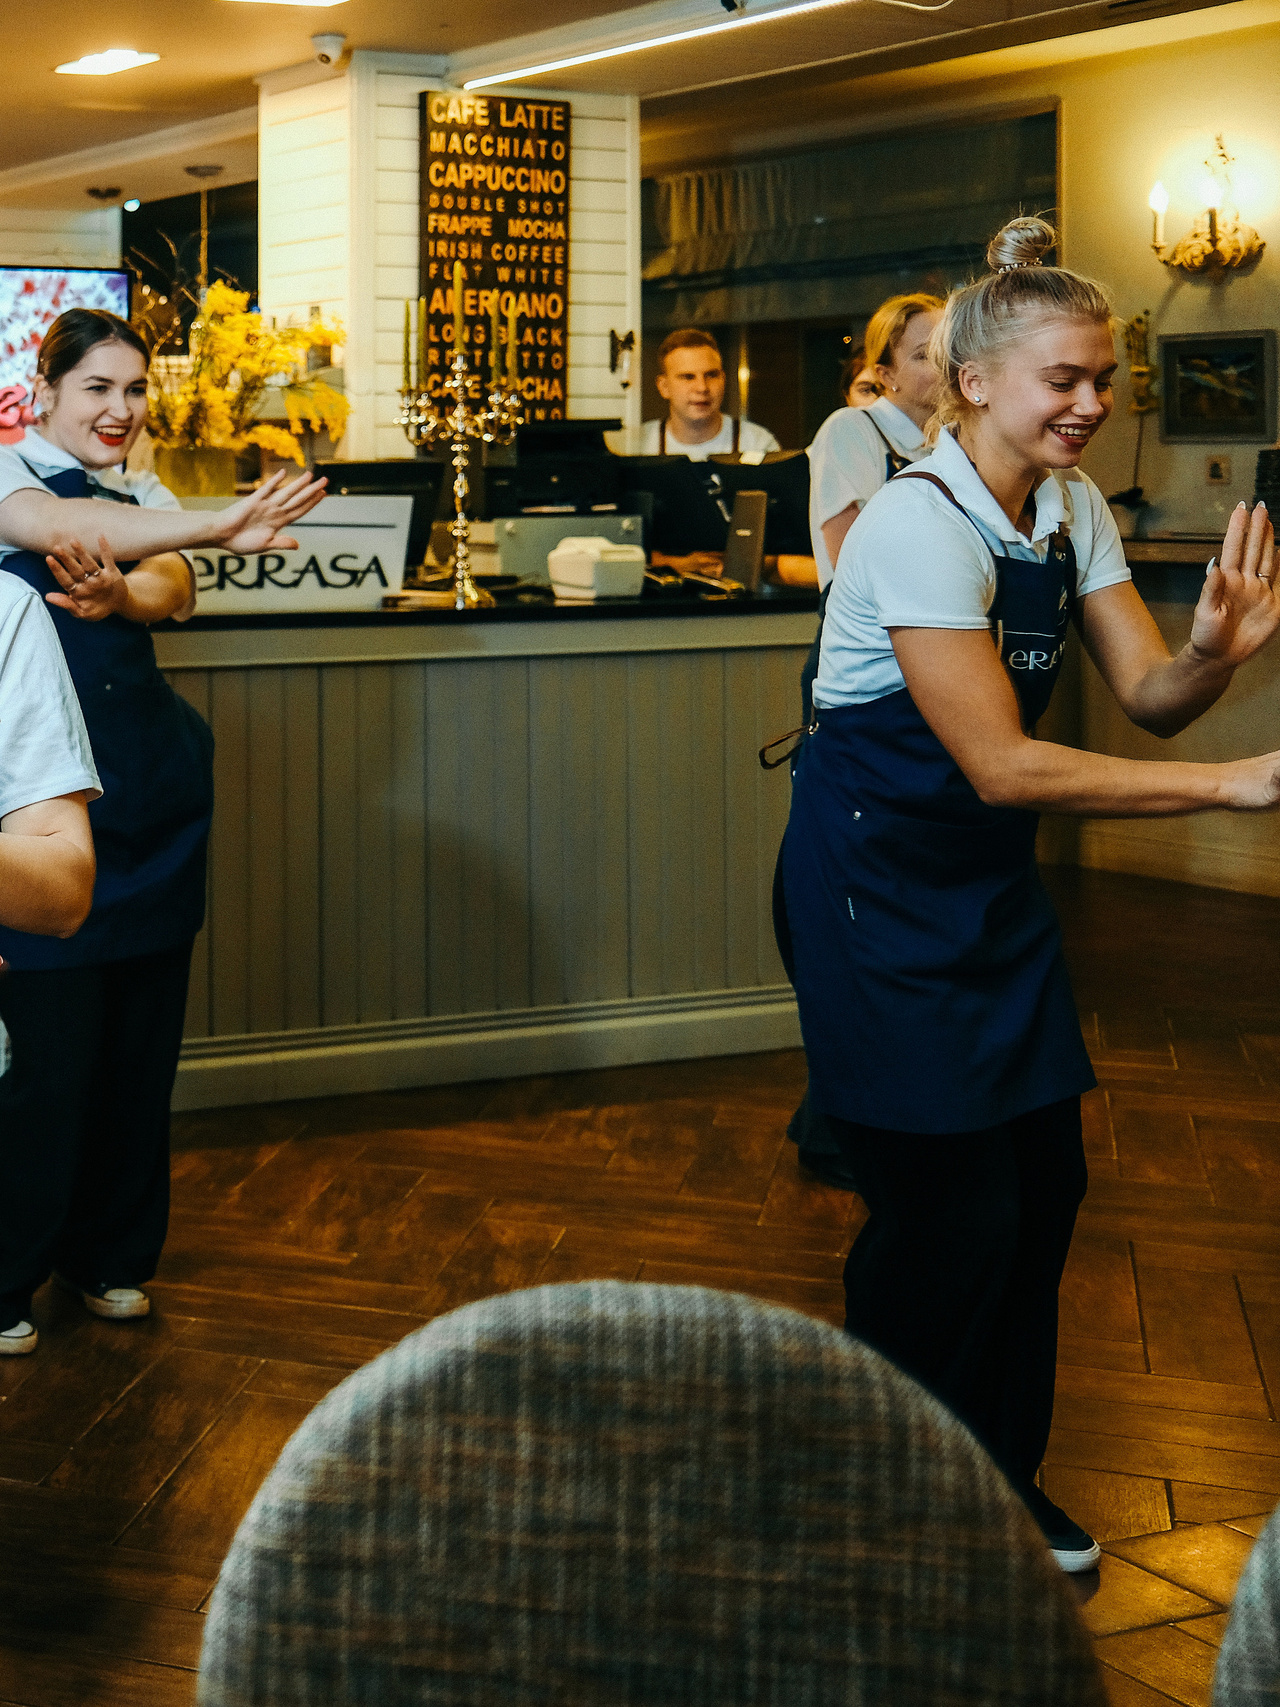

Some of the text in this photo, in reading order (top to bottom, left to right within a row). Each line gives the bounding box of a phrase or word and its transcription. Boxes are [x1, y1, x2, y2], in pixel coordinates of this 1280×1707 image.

[430, 96, 565, 131] CAFE LATTE
[429, 131, 566, 161] MACCHIATO
[428, 161, 566, 195] CAPPUCCINO
[429, 192, 565, 215] DOUBLE SHOT
[427, 212, 566, 240] FRAPPE MOCHA
[428, 240, 565, 264] IRISH COFFEE
[496, 267, 564, 286] WHITE
[497, 325, 563, 346] BACK
